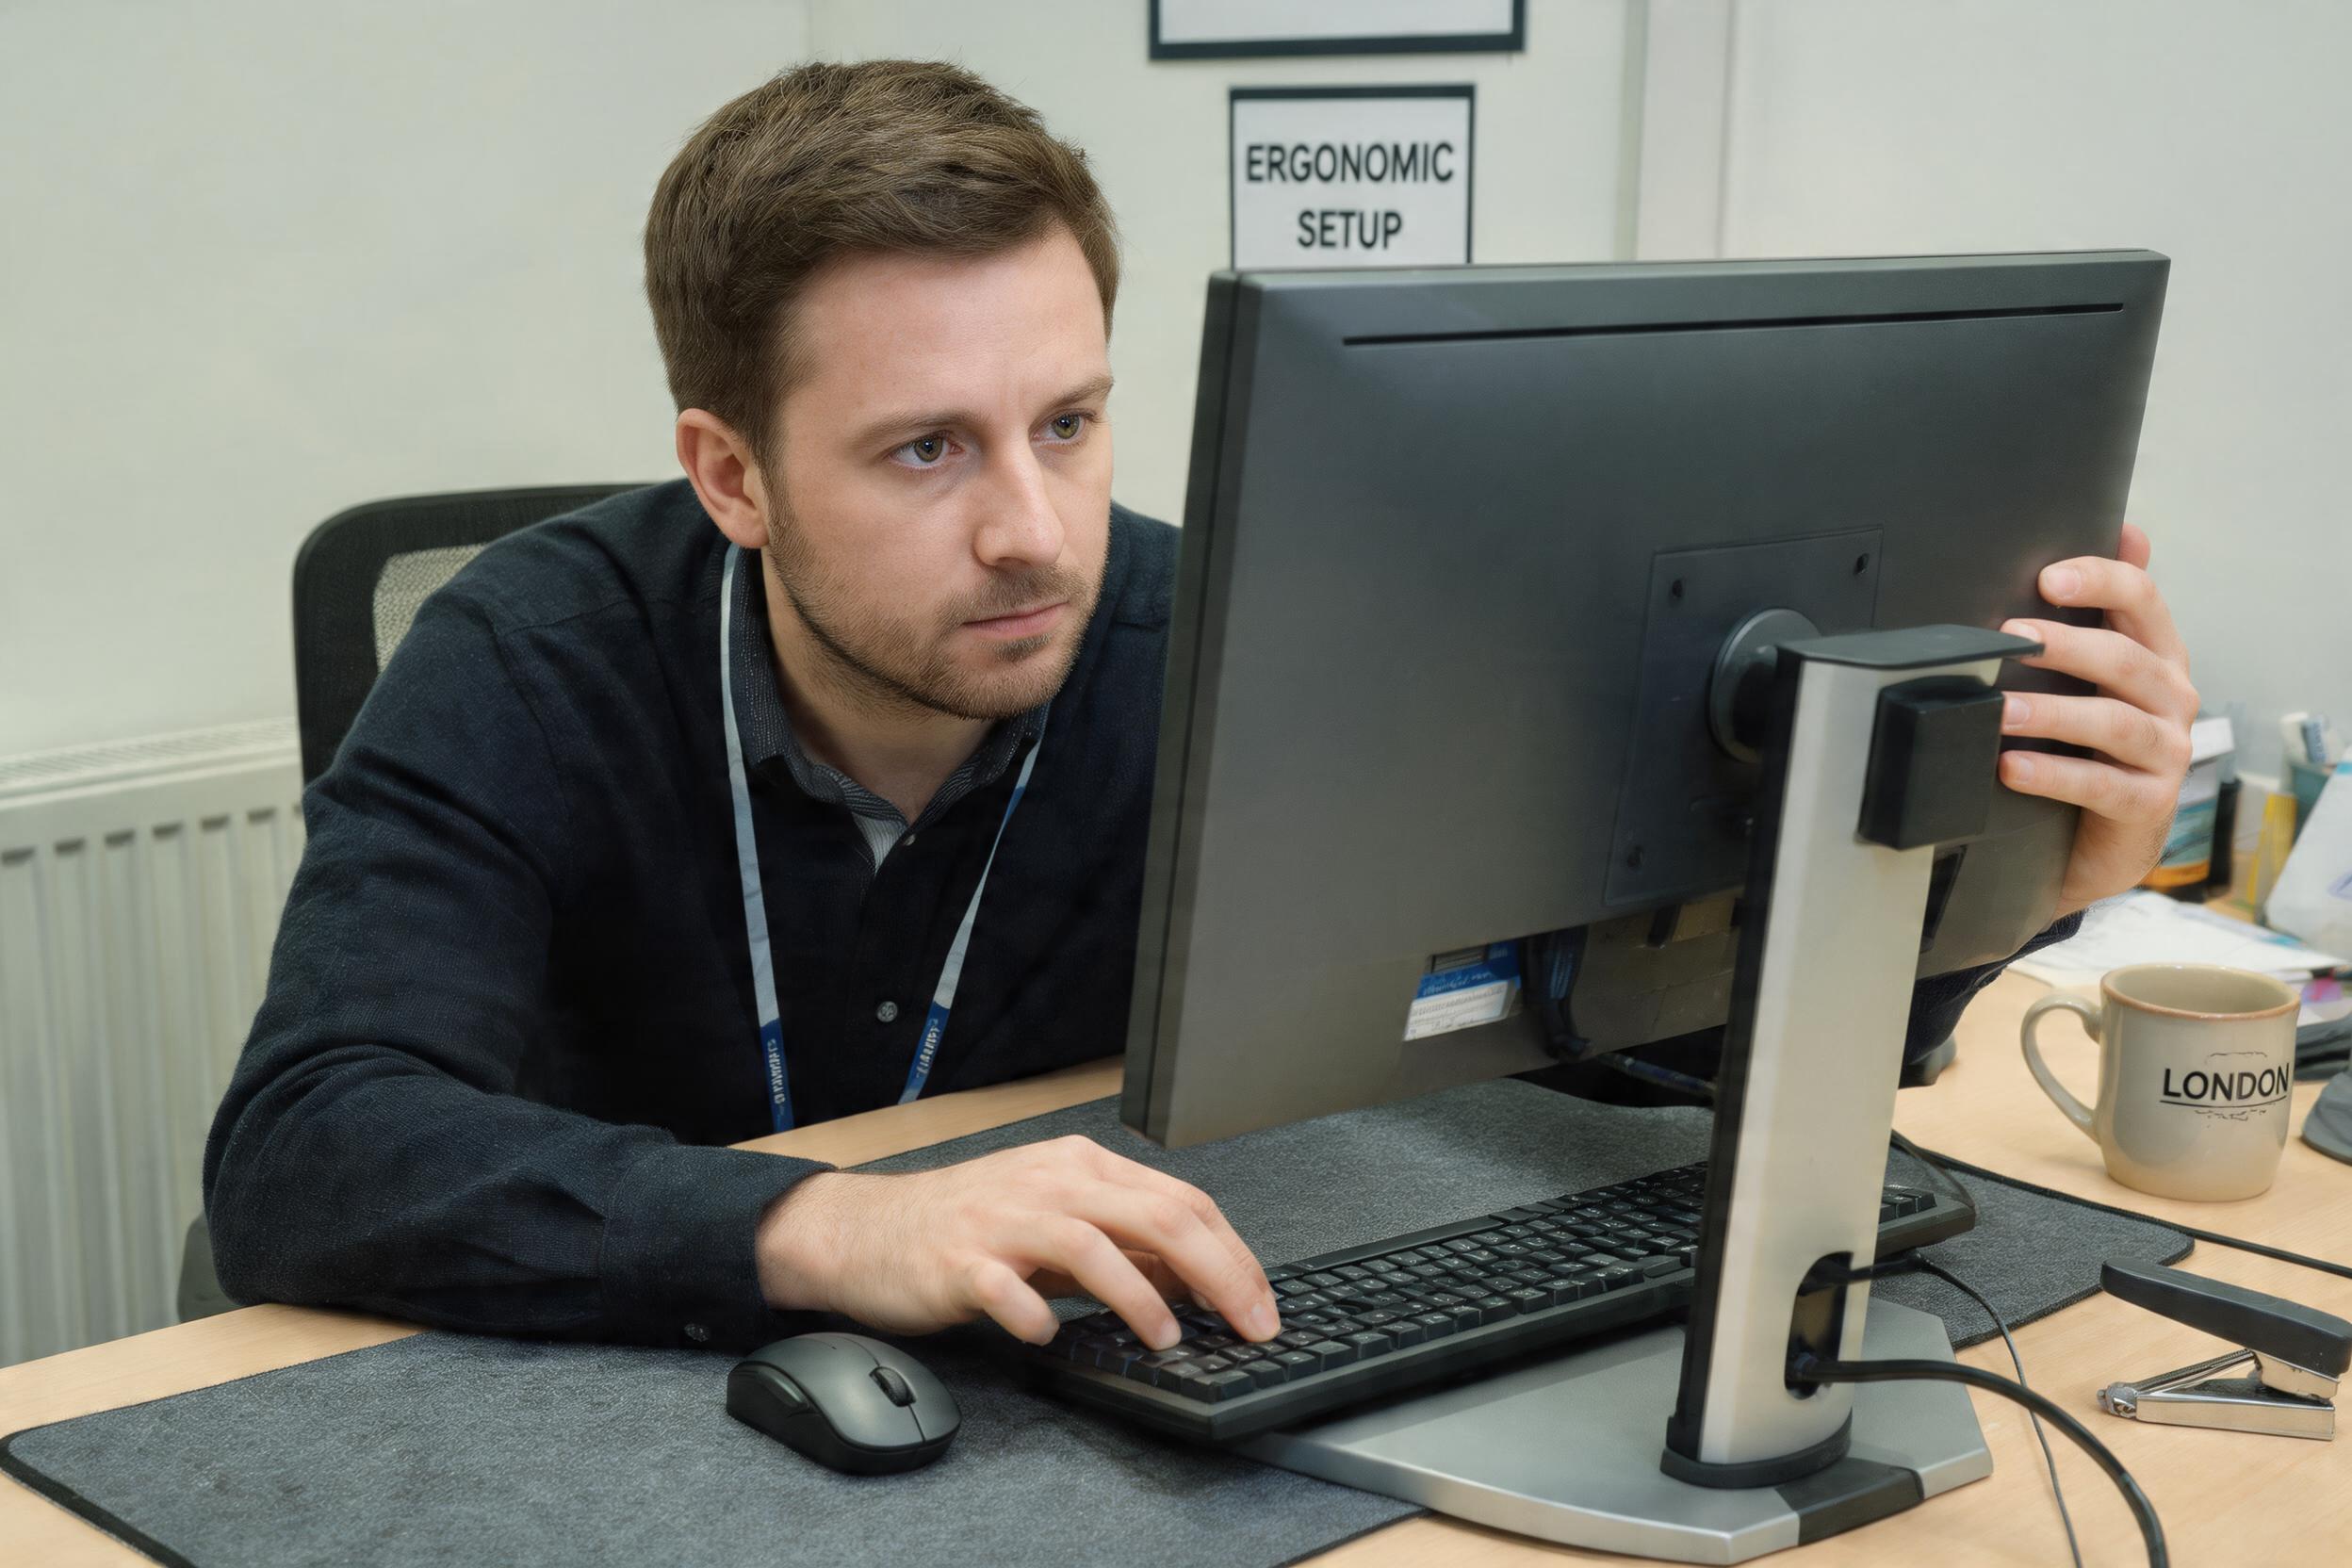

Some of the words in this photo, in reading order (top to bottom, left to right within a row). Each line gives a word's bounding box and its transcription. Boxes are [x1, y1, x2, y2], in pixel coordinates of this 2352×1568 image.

[1247, 141, 1455, 183] ERGONOMIC
[1298, 209, 1402, 251] SETUP
[2163, 1062, 2290, 1101] LONDON
